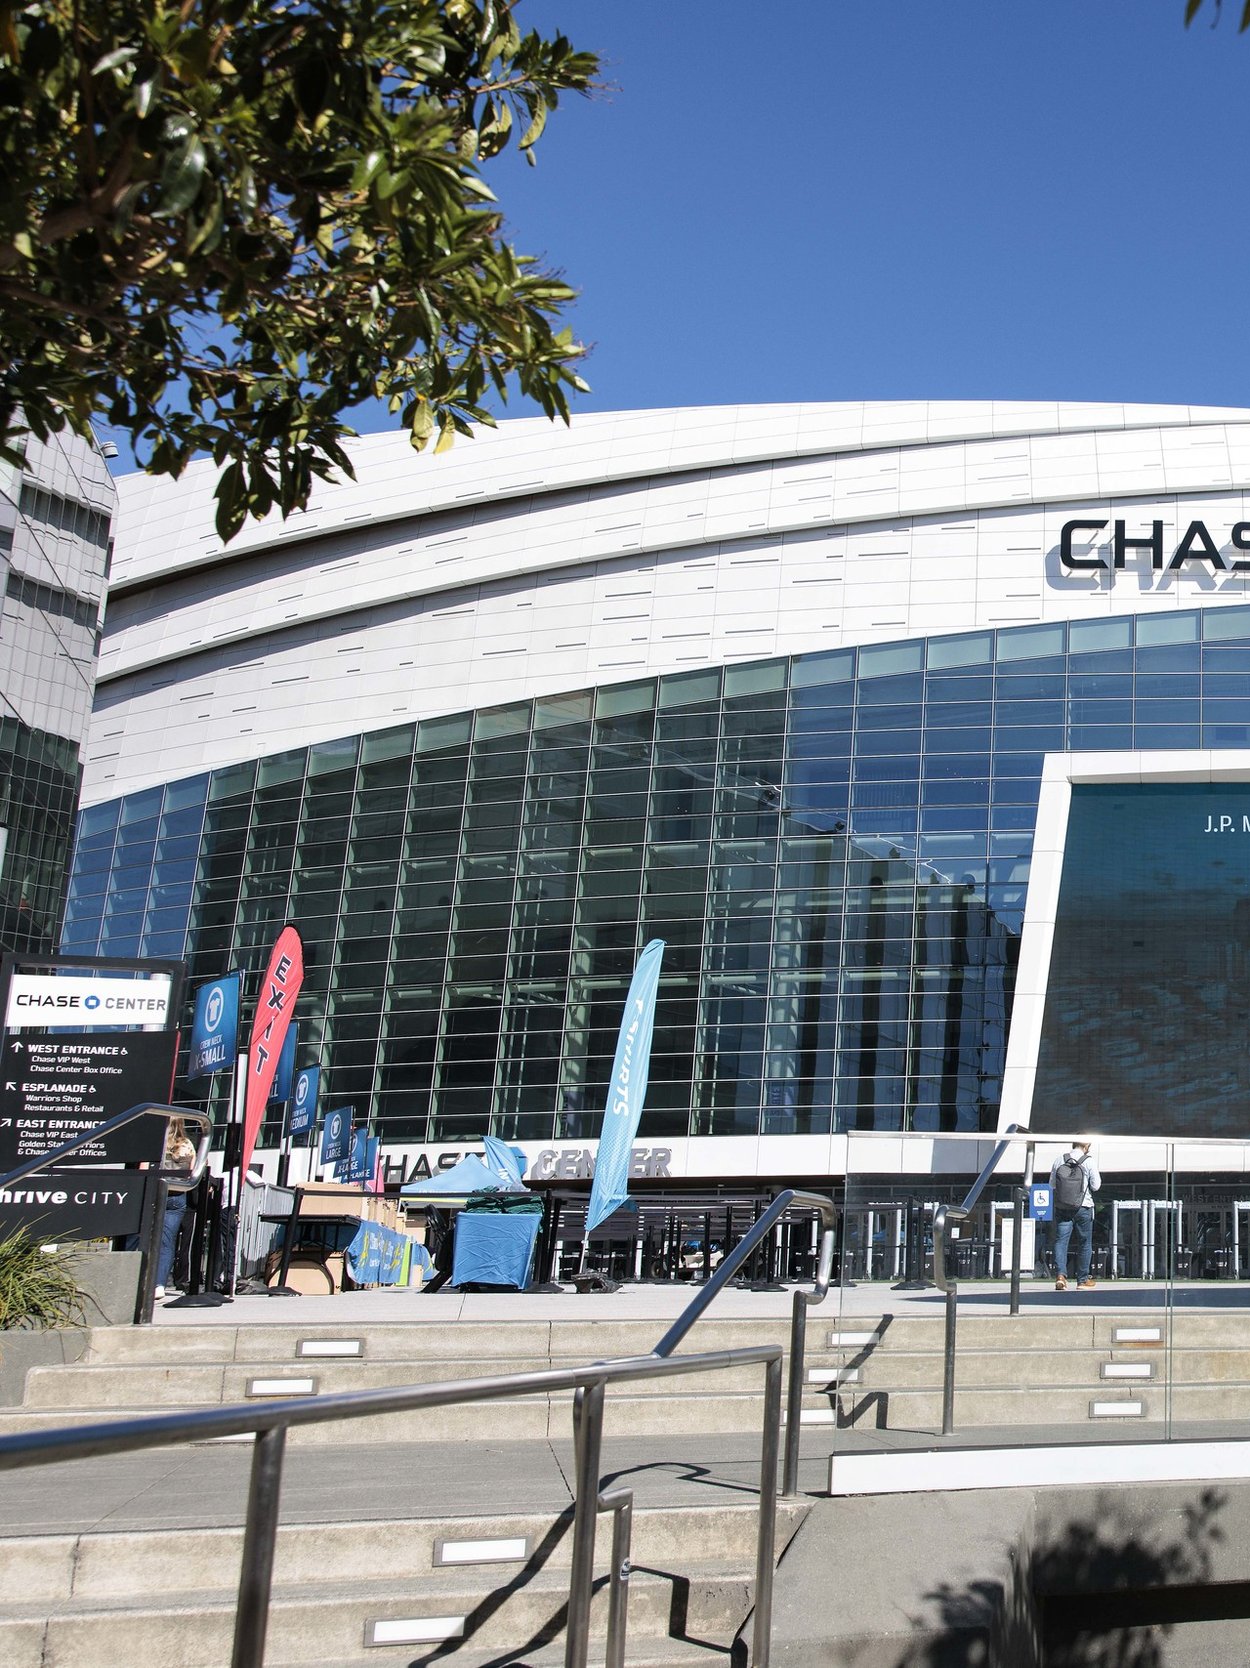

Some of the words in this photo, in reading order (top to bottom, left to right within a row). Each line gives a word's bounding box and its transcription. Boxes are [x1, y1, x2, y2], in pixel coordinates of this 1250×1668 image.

[1204, 815, 1235, 833] J.P.
[16, 994, 81, 1008] CHASE
[105, 997, 166, 1011] CENTER
[256, 952, 293, 1076] EXIT
[28, 1044, 60, 1054] WEST
[62, 1045, 119, 1055] ENTRANCE
[32, 1055, 56, 1063] Chase
[194, 1044, 226, 1071] X-SMALL
[30, 1065, 55, 1073] Chase
[56, 1065, 82, 1073] Center
[100, 1066, 123, 1074] Office
[22, 1083, 87, 1093] ESPLANADE
[26, 1094, 61, 1102] Warriors
[62, 1095, 82, 1103] Shop
[24, 1104, 73, 1112] Restaurants
[82, 1105, 104, 1113] Retail
[16, 1119, 46, 1128] EAST
[48, 1120, 106, 1129] ENTRANC
[20, 1130, 45, 1138] Chase
[60, 1131, 78, 1139] East
[19, 1140, 46, 1148] Golden
[79, 1149, 107, 1157] Offices
[326, 1147, 341, 1160] LARGE
[379, 1151, 487, 1182] HAS
[536, 1148, 672, 1178] CENER
[74, 1191, 128, 1205] CITY
